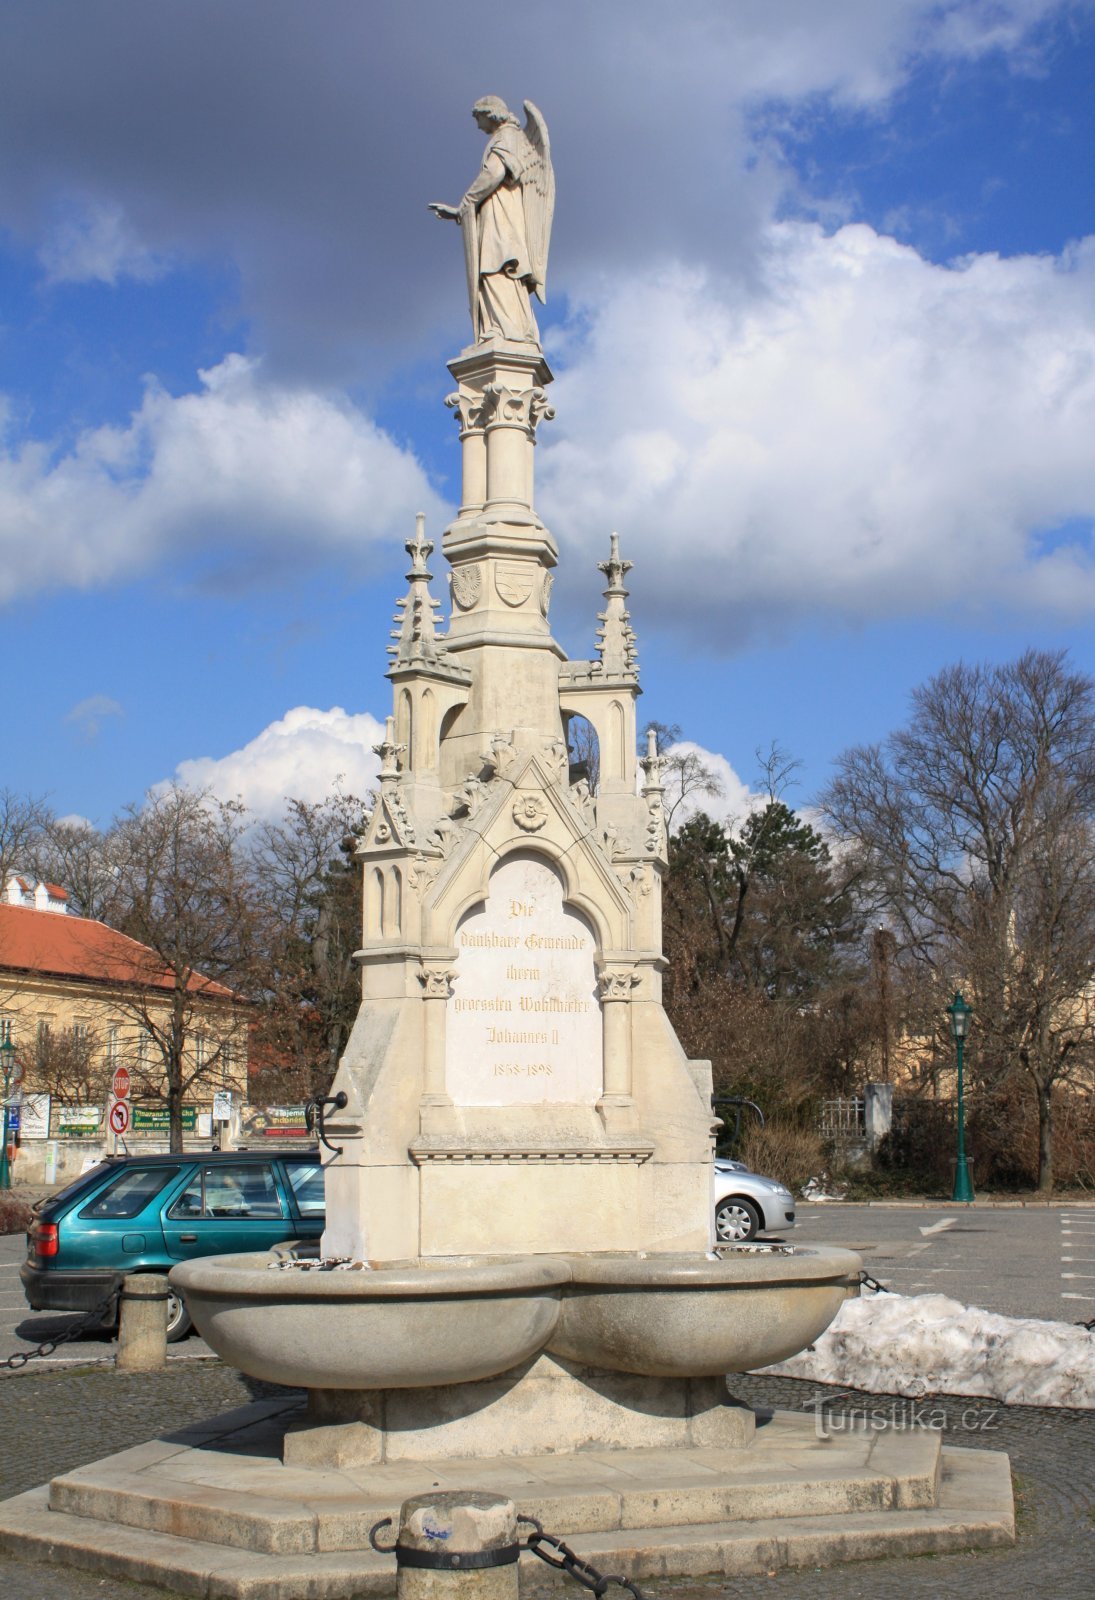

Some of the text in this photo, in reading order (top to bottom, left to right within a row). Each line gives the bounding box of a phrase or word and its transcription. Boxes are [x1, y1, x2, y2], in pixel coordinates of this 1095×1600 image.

[510, 900, 535, 919] Die
[461, 931, 585, 950] dankbare Gemeinde
[506, 964, 542, 981] ihrem
[486, 1027, 548, 1044] Johannes
[494, 1063, 553, 1076] 1858-1898
[114, 1077, 129, 1090] STOP
